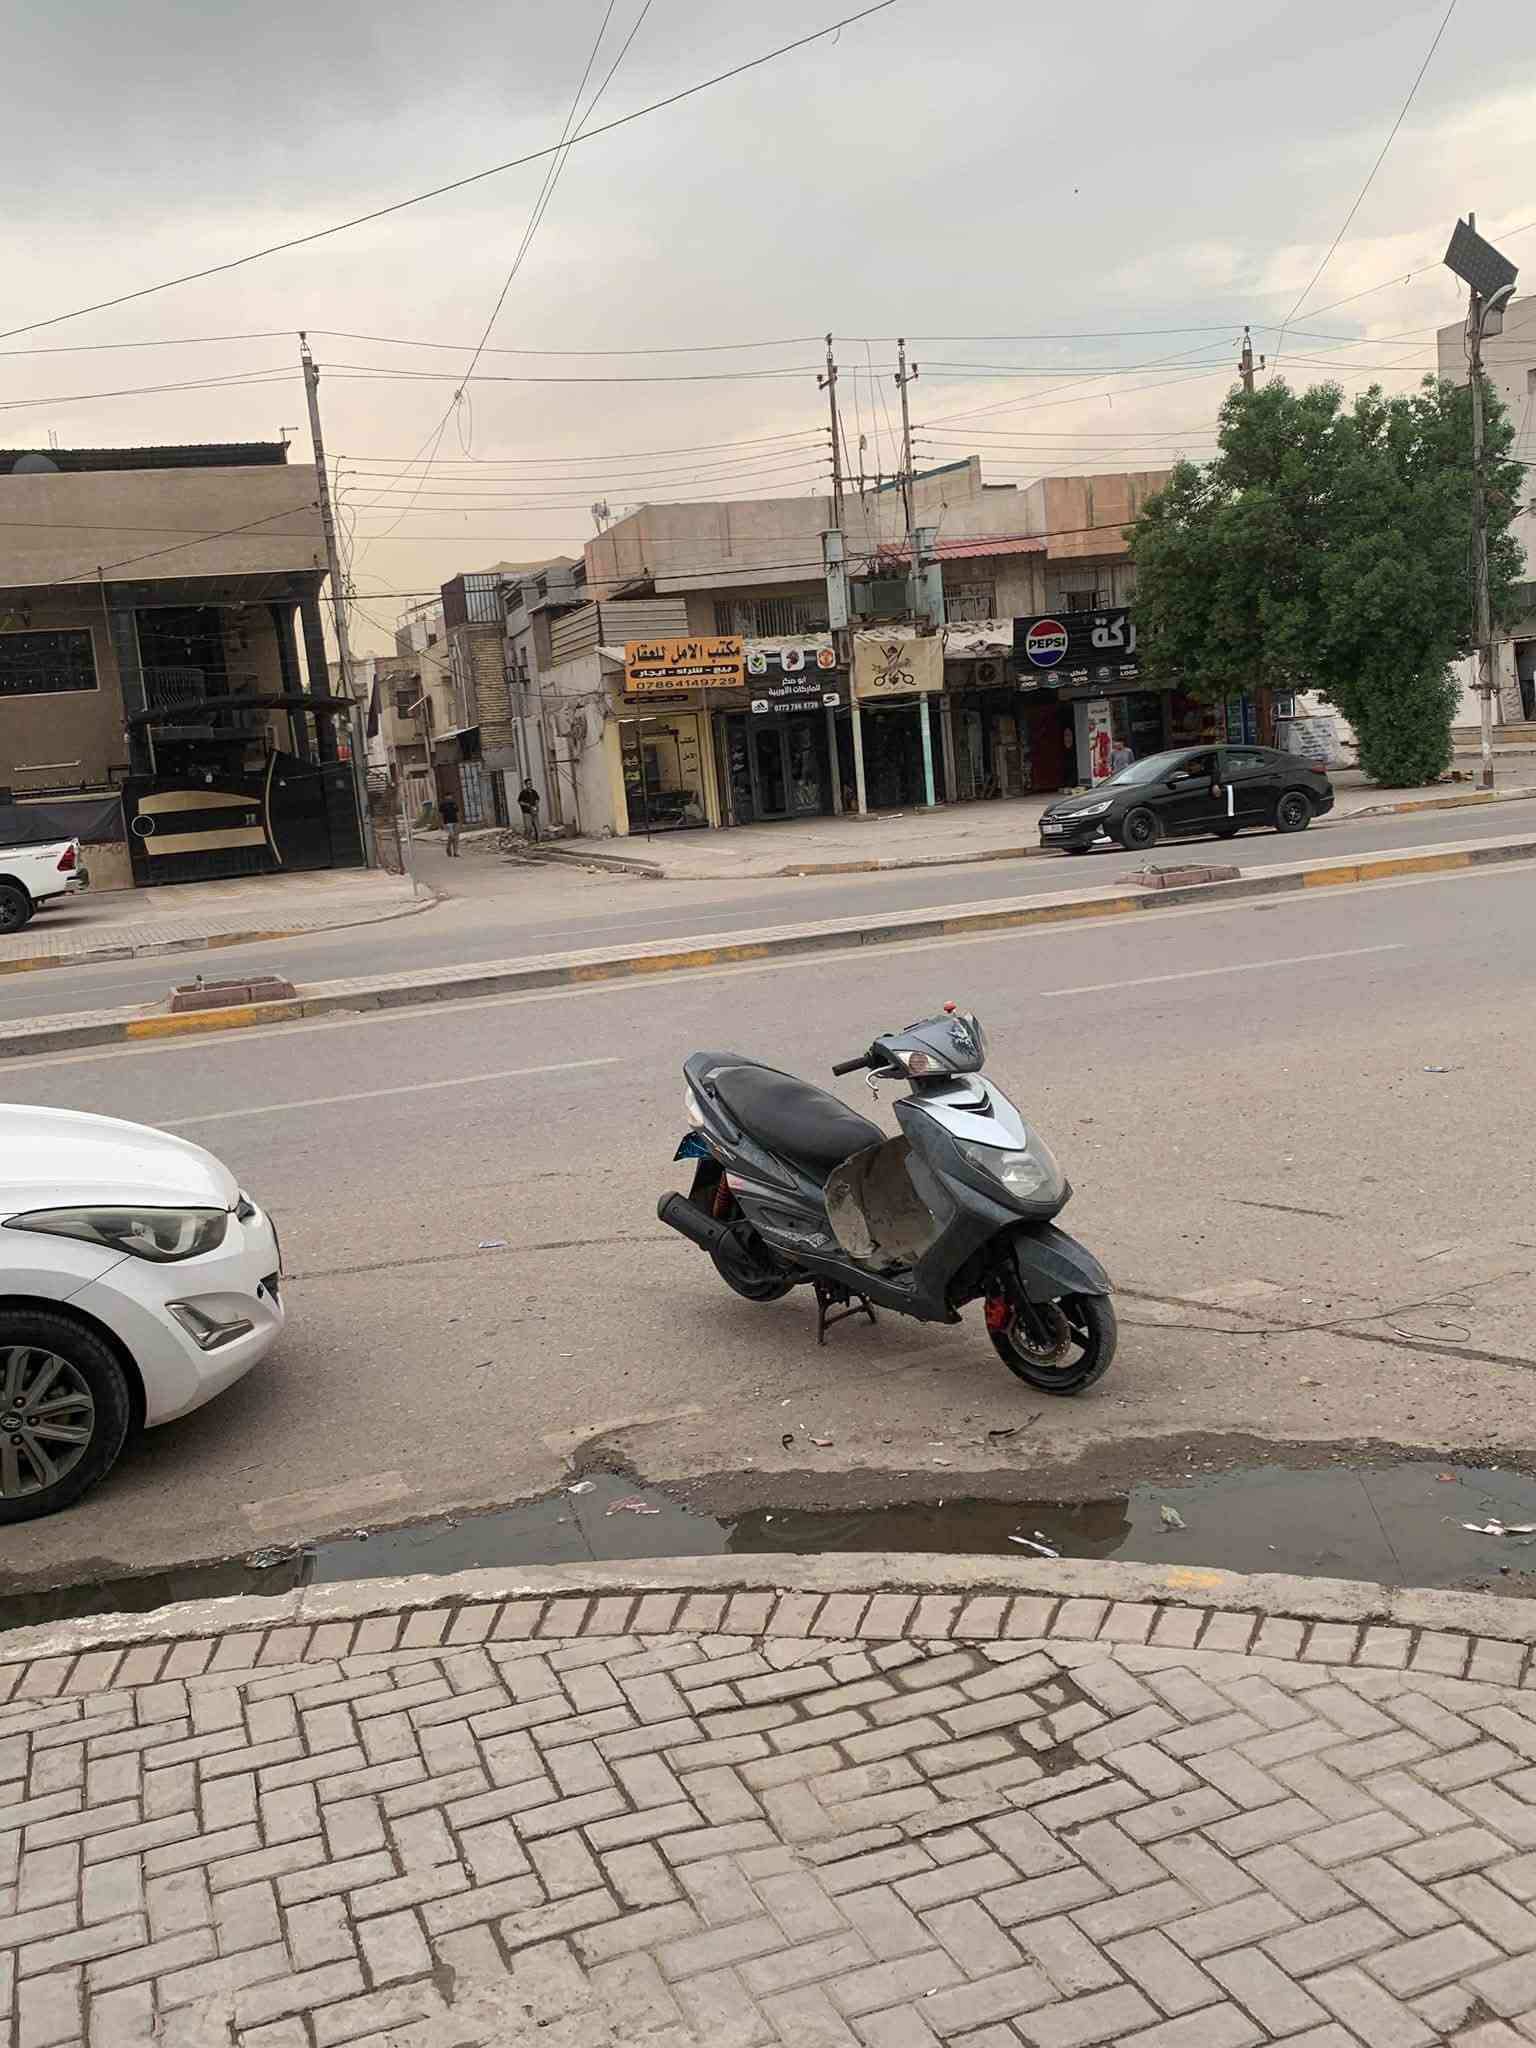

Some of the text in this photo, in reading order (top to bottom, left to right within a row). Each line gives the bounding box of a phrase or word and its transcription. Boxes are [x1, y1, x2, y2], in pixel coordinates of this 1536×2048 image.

[1028, 637, 1066, 650] PEPSI
[628, 640, 740, 666] مكتب الامل للعقار
[636, 677, 737, 690] 07864149729
